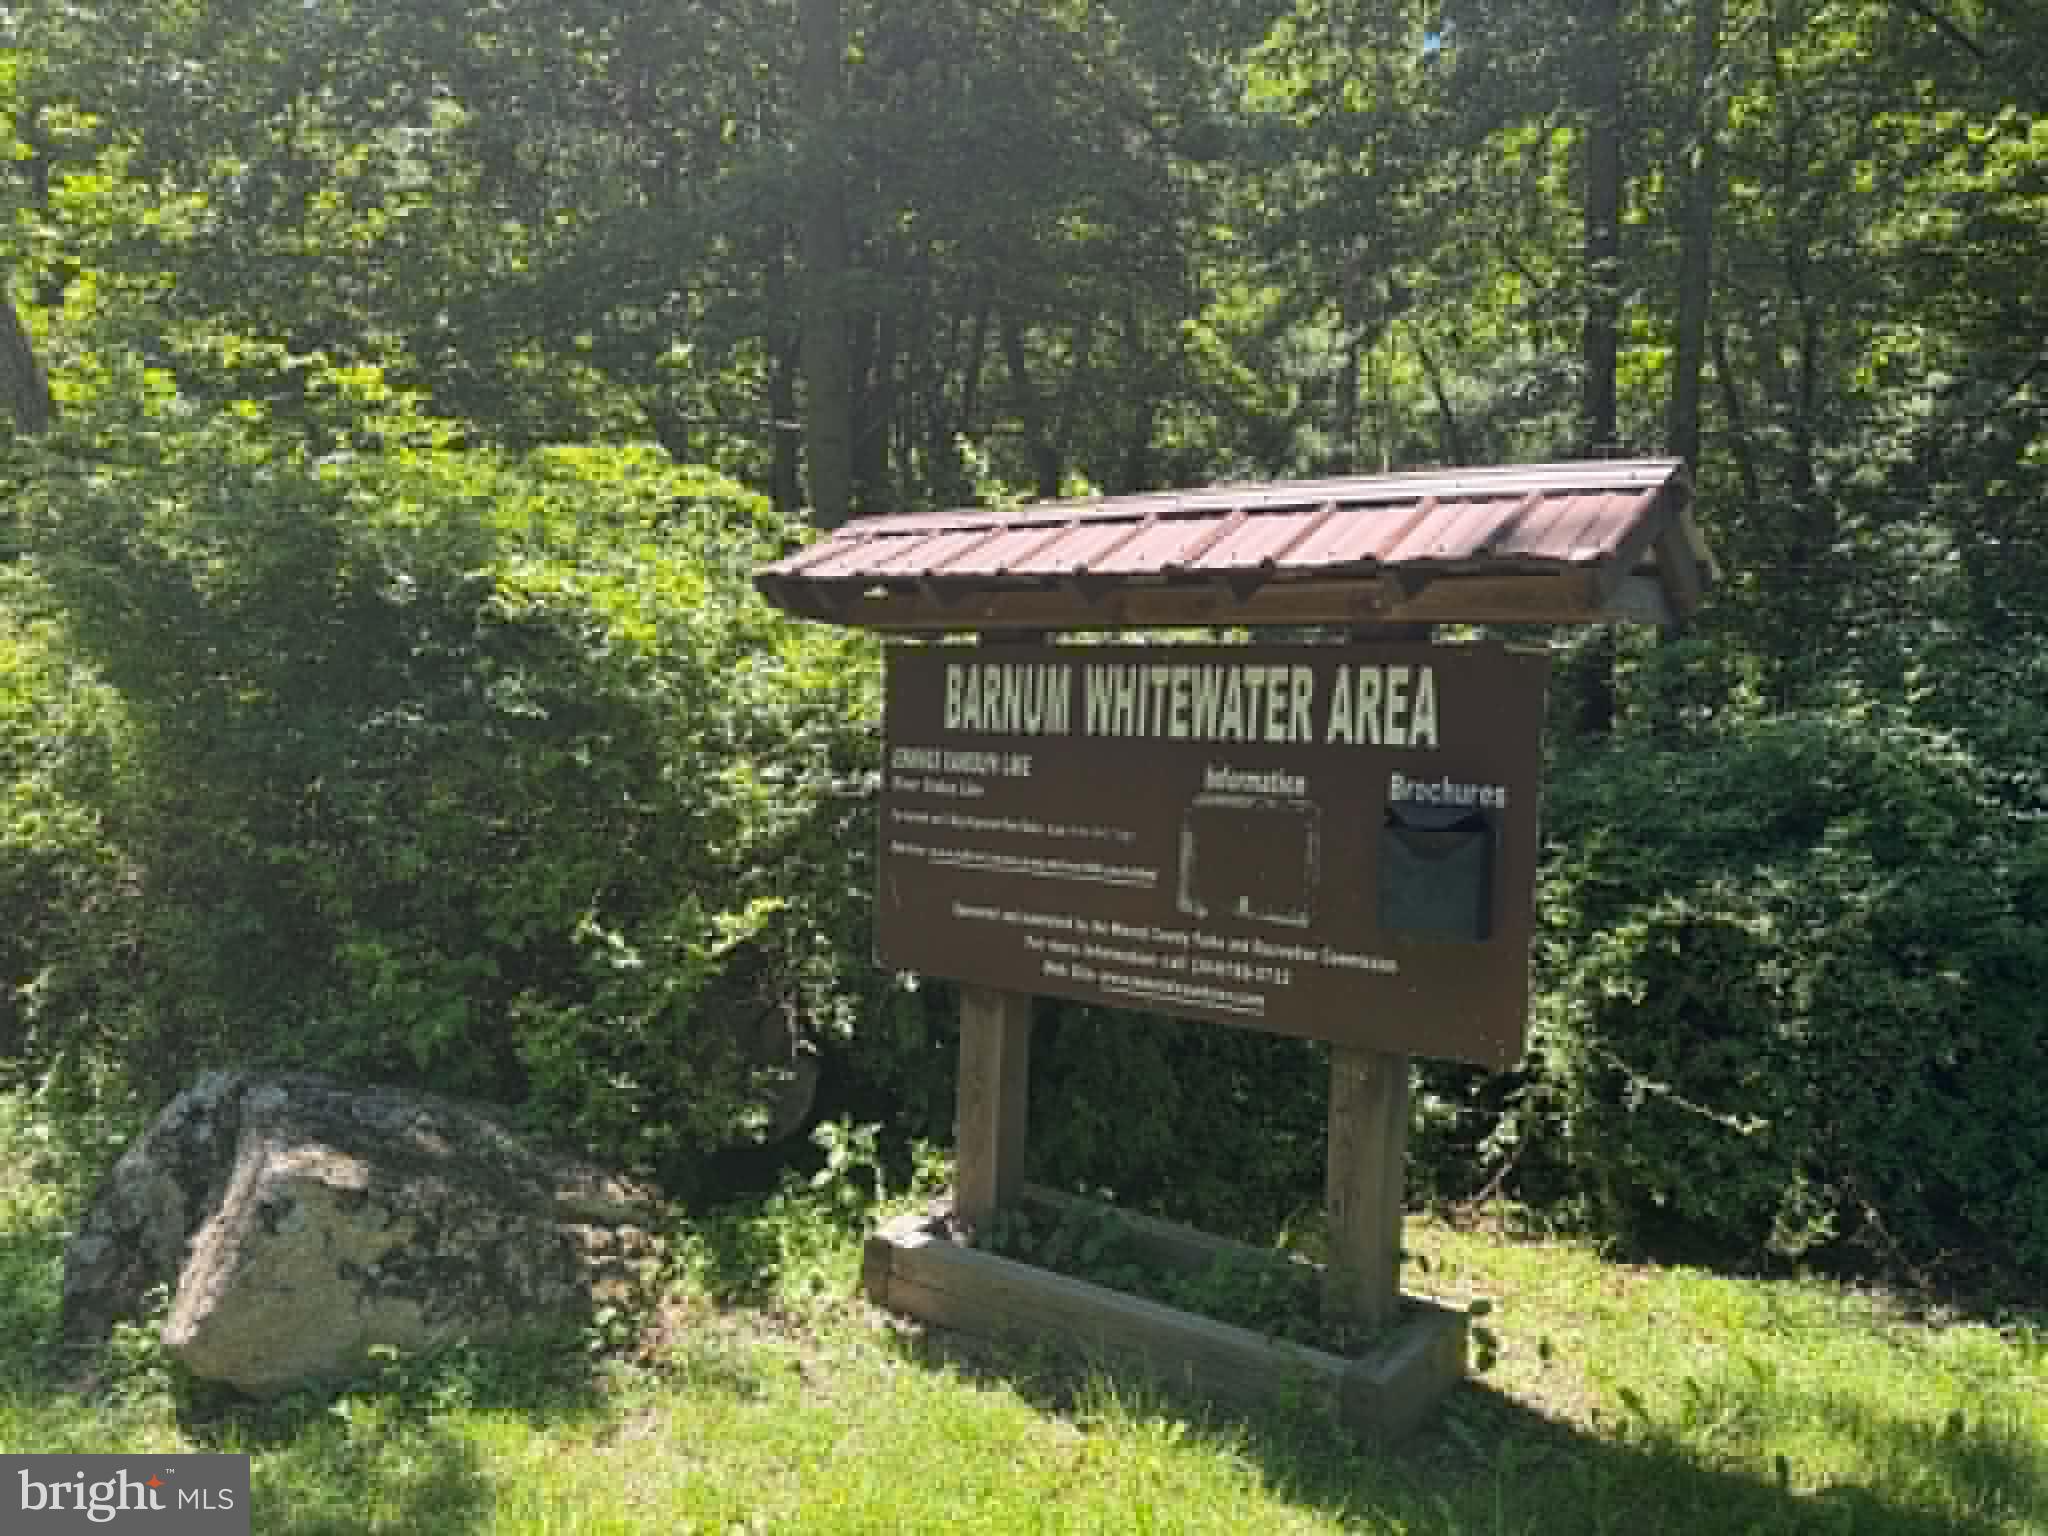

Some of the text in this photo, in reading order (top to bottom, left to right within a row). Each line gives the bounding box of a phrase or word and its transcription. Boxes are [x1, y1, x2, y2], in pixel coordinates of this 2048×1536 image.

[944, 664, 1440, 750] BARNUM WHITEWATER AREA
[1390, 771, 1506, 808] Brochures
